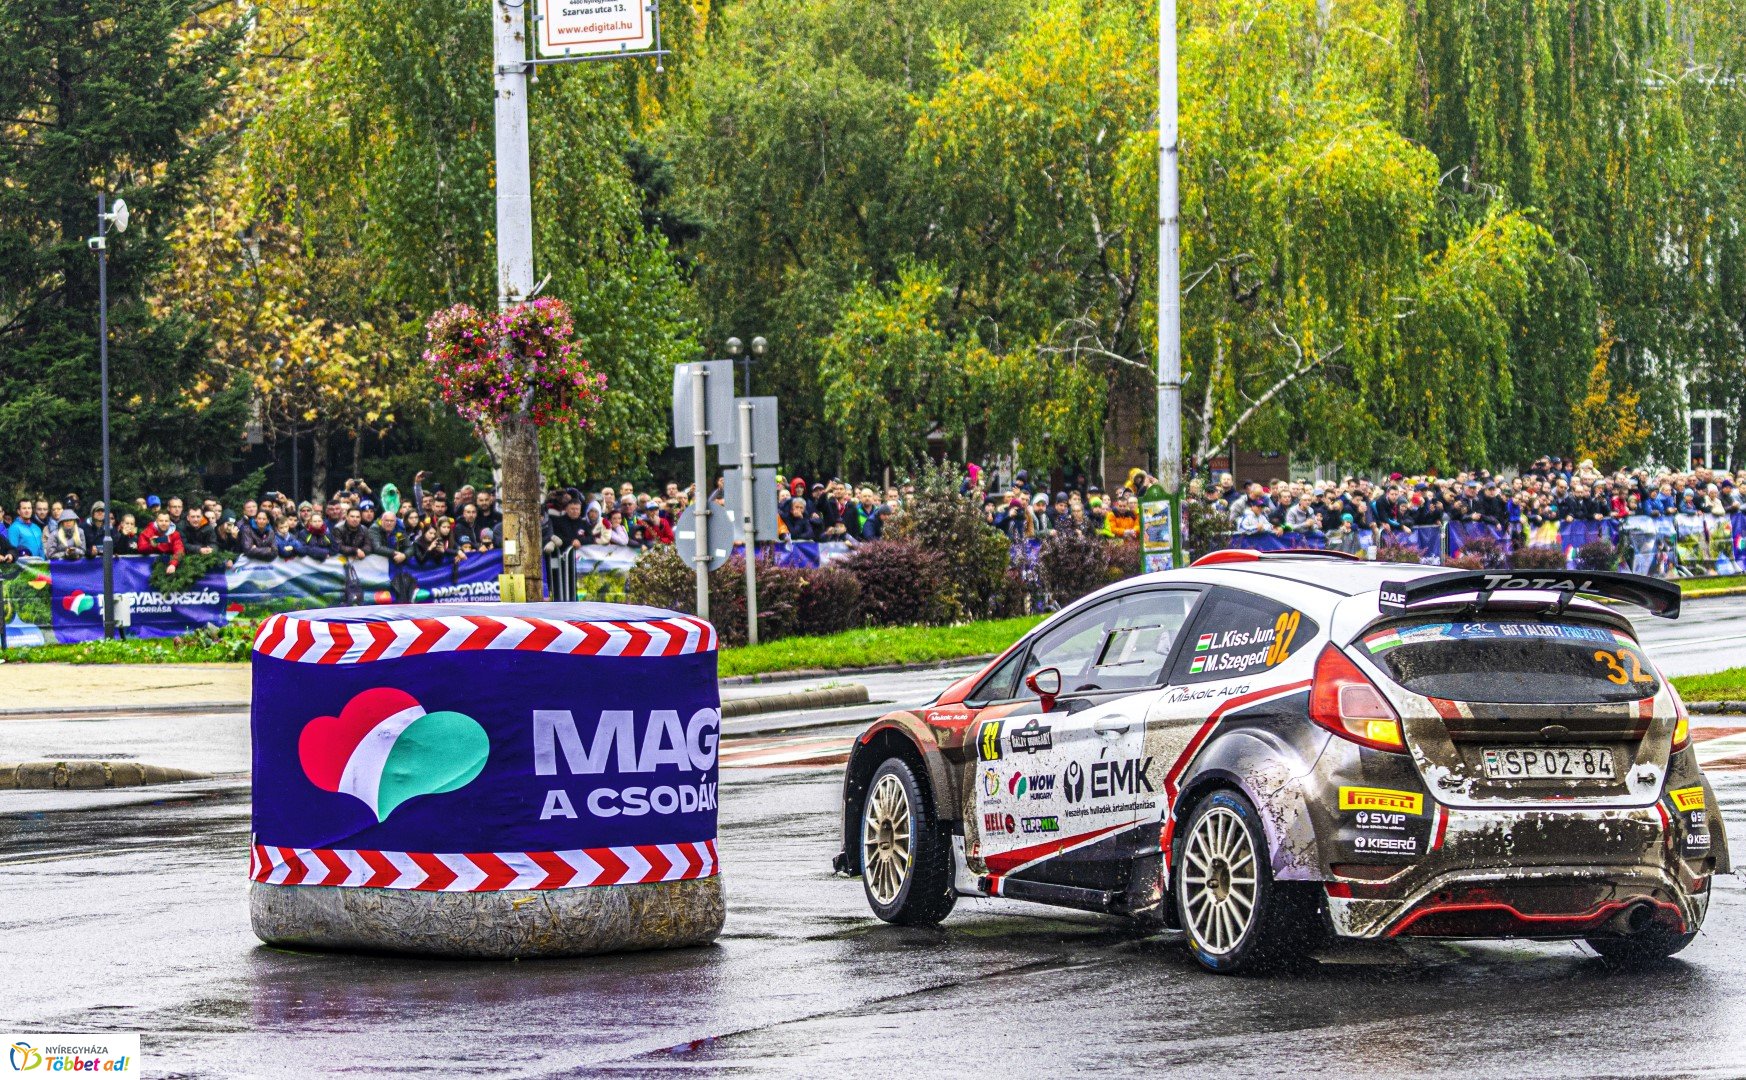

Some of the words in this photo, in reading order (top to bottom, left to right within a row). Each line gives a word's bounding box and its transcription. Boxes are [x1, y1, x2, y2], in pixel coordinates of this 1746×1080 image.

[562, 7, 593, 16] Szarvas
[595, 5, 612, 14] utca
[613, 4, 627, 12] 13.
[557, 21, 633, 34] www.edigital.hu
[1483, 574, 1600, 593] TOTAL
[1380, 591, 1406, 603] DAF
[136, 605, 172, 613] FORRÁSA
[1210, 630, 1249, 650] L.Kiss
[1250, 627, 1276, 645] Jun.
[1265, 609, 1301, 667] 32
[1500, 624, 1520, 636] GOT
[1521, 625, 1564, 637] TALENT?
[1204, 646, 1269, 672] M.Szegedi
[1594, 649, 1654, 685] 32
[533, 707, 721, 776] MAG
[1091, 746, 1154, 799] ÉMK
[1029, 774, 1056, 791] WOW
[540, 789, 578, 820] A
[587, 773, 717, 818] CSODÁK
[1030, 792, 1053, 800] HUNGARY
[1348, 791, 1415, 808] PIRELLI
[984, 812, 1005, 832] HELL
[1370, 813, 1406, 825] SVIP
[1367, 836, 1416, 850] KISERŐ
